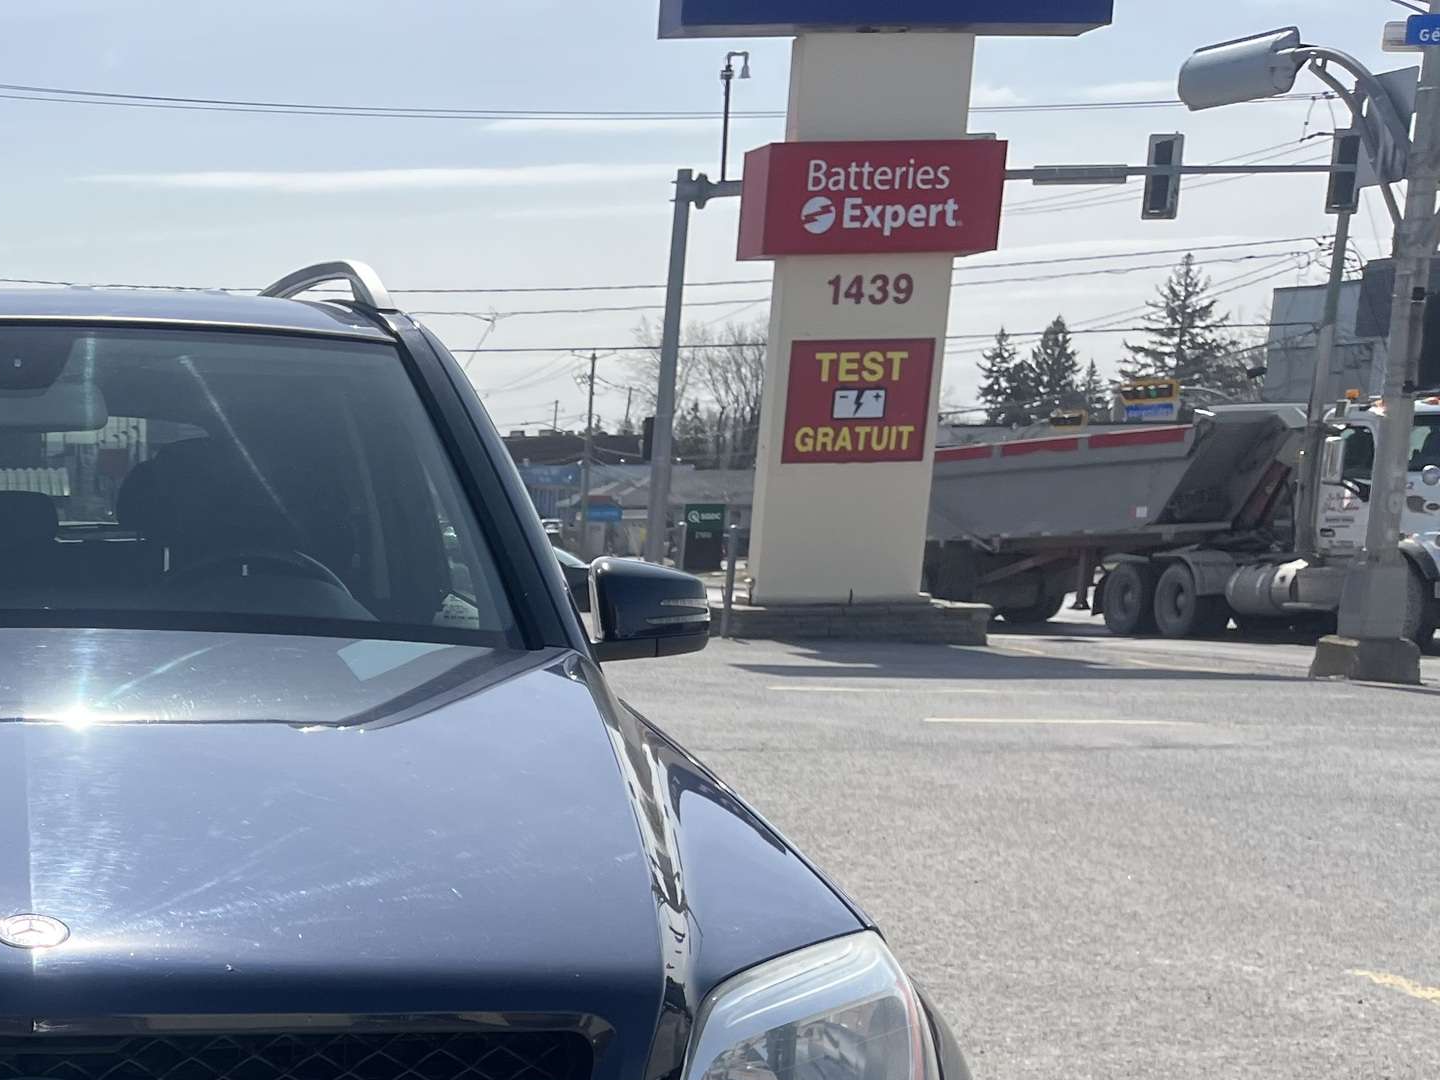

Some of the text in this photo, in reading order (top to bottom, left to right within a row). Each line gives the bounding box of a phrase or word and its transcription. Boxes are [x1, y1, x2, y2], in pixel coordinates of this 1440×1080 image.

[807, 158, 951, 192] Batteries
[842, 198, 959, 236] Expert
[827, 273, 914, 305] 1439
[815, 351, 909, 382] TEST
[794, 425, 915, 453] GRATUIT
